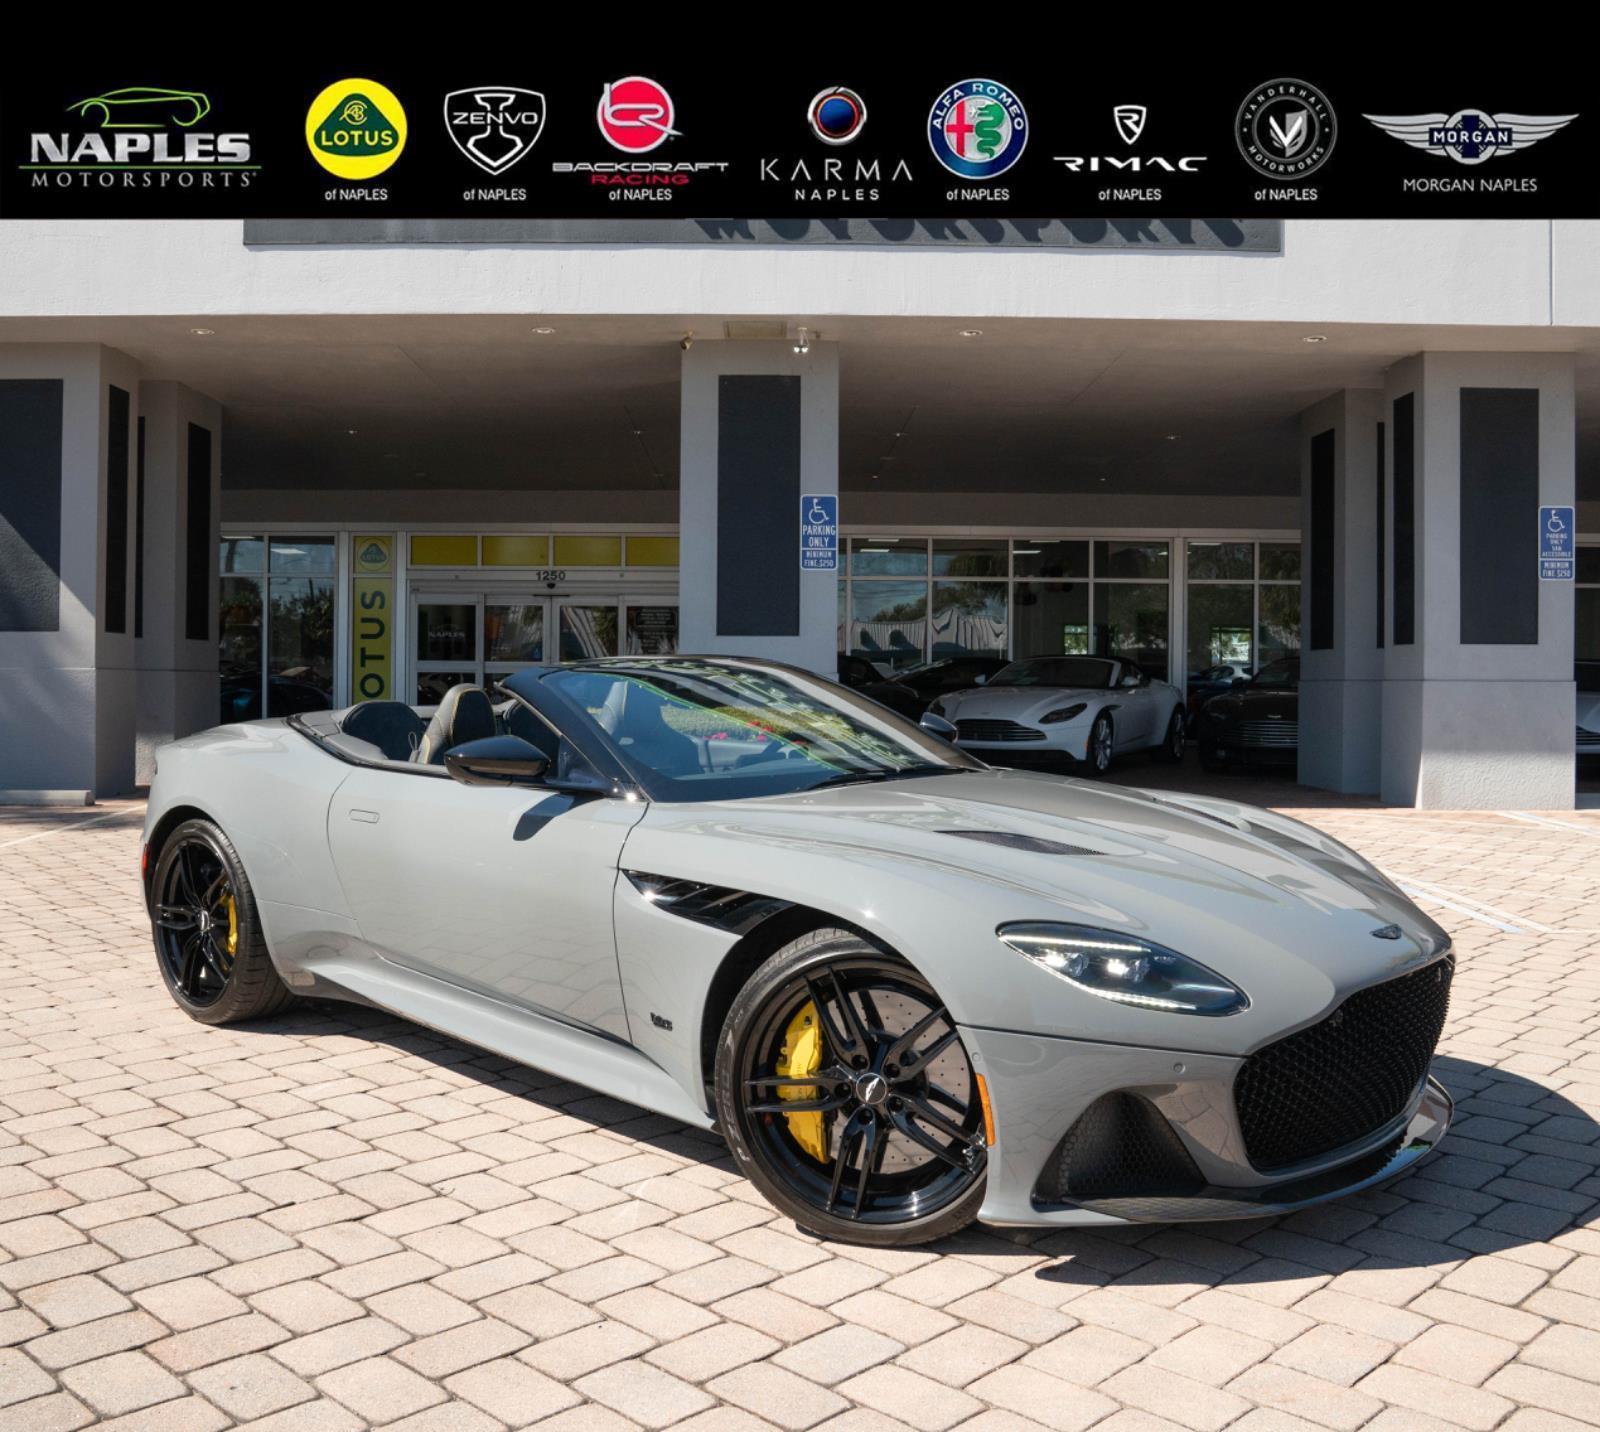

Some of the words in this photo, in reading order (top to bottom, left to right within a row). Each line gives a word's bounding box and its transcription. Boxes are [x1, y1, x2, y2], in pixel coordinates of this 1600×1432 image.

[802, 525, 836, 536] PARKING
[808, 537, 829, 548] ONLY
[536, 571, 566, 581] 1250
[360, 591, 385, 698] OTUS
